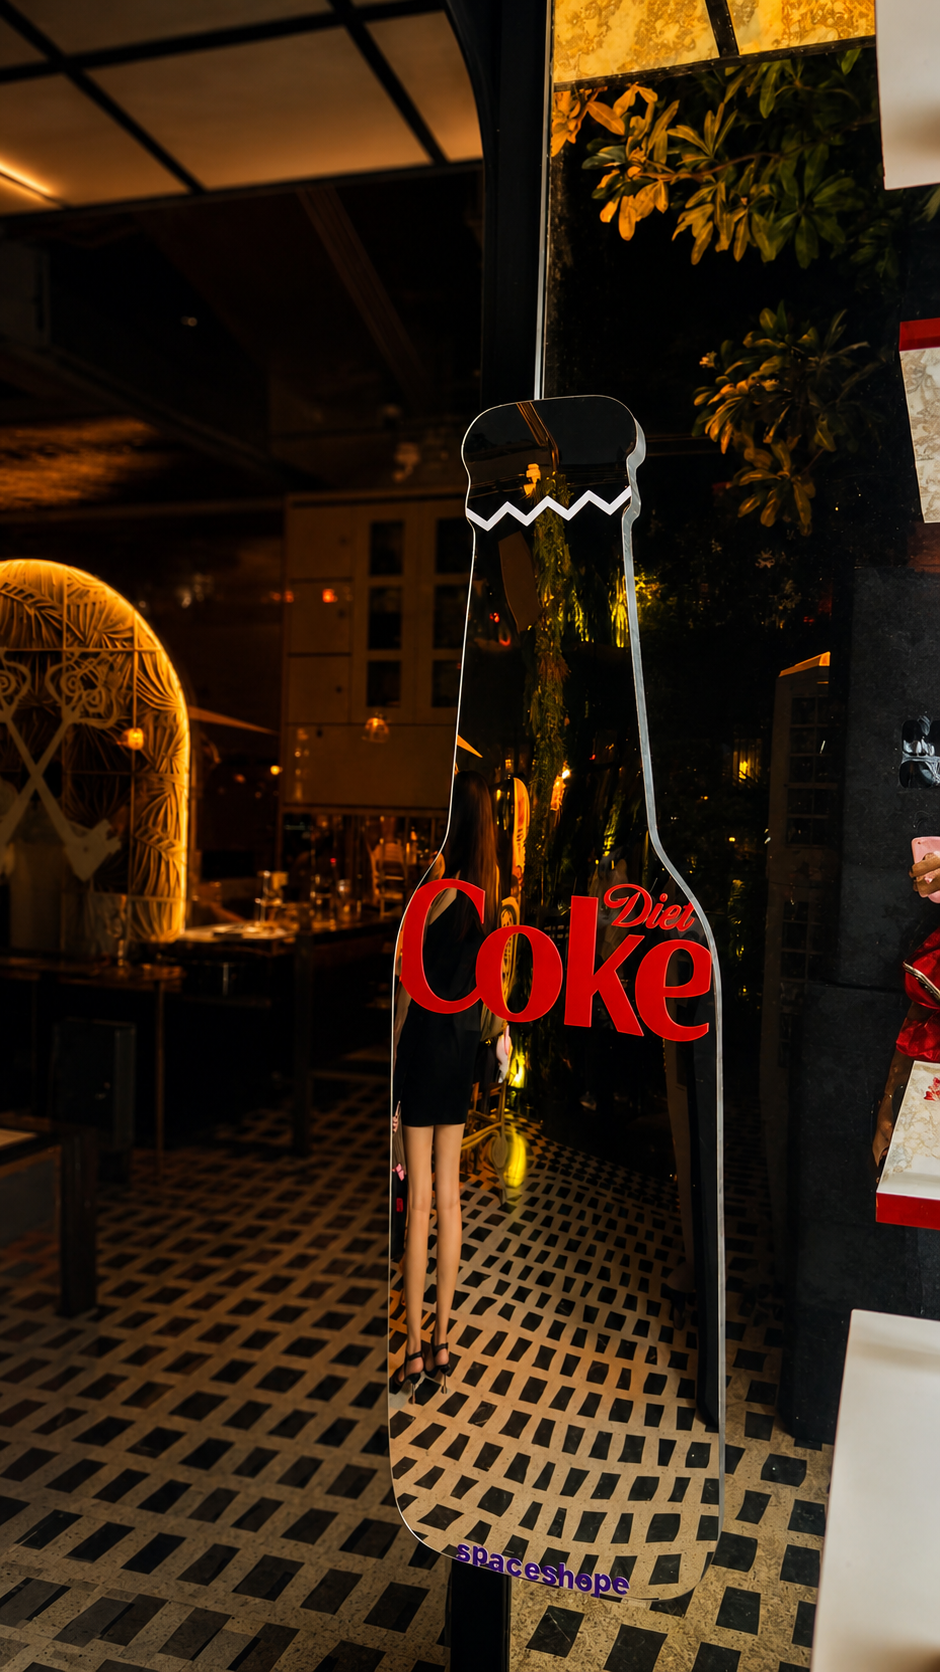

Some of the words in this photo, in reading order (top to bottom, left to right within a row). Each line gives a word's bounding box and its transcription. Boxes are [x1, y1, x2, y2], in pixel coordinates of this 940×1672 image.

[603, 883, 696, 932] Diet
[400, 878, 712, 1042] Coke
[456, 1543, 630, 1598] spaceshope
